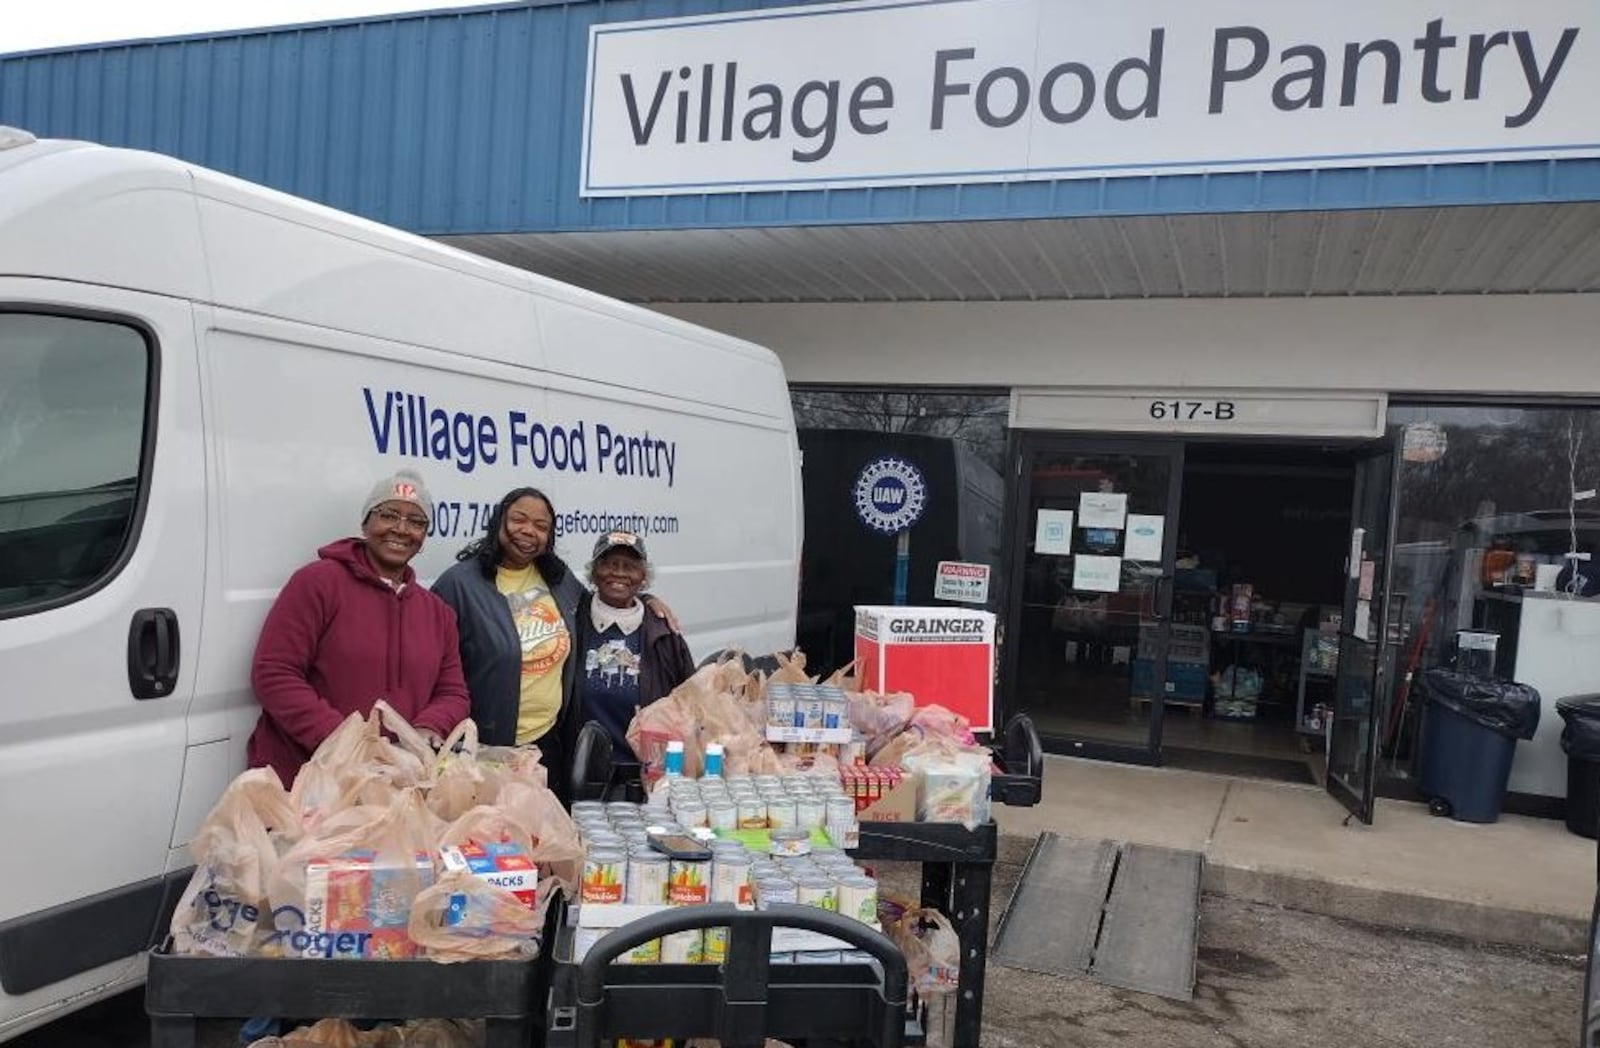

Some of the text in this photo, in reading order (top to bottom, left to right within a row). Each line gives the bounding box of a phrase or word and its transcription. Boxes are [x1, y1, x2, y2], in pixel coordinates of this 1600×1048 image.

[620, 18, 1581, 163] Village Food Pantry
[1149, 400, 1236, 421] 617-B
[363, 387, 676, 488] Village Food Pantry
[873, 487, 905, 504] UAW
[942, 565, 985, 577] WARNING
[889, 619, 985, 634] GRAINGER
